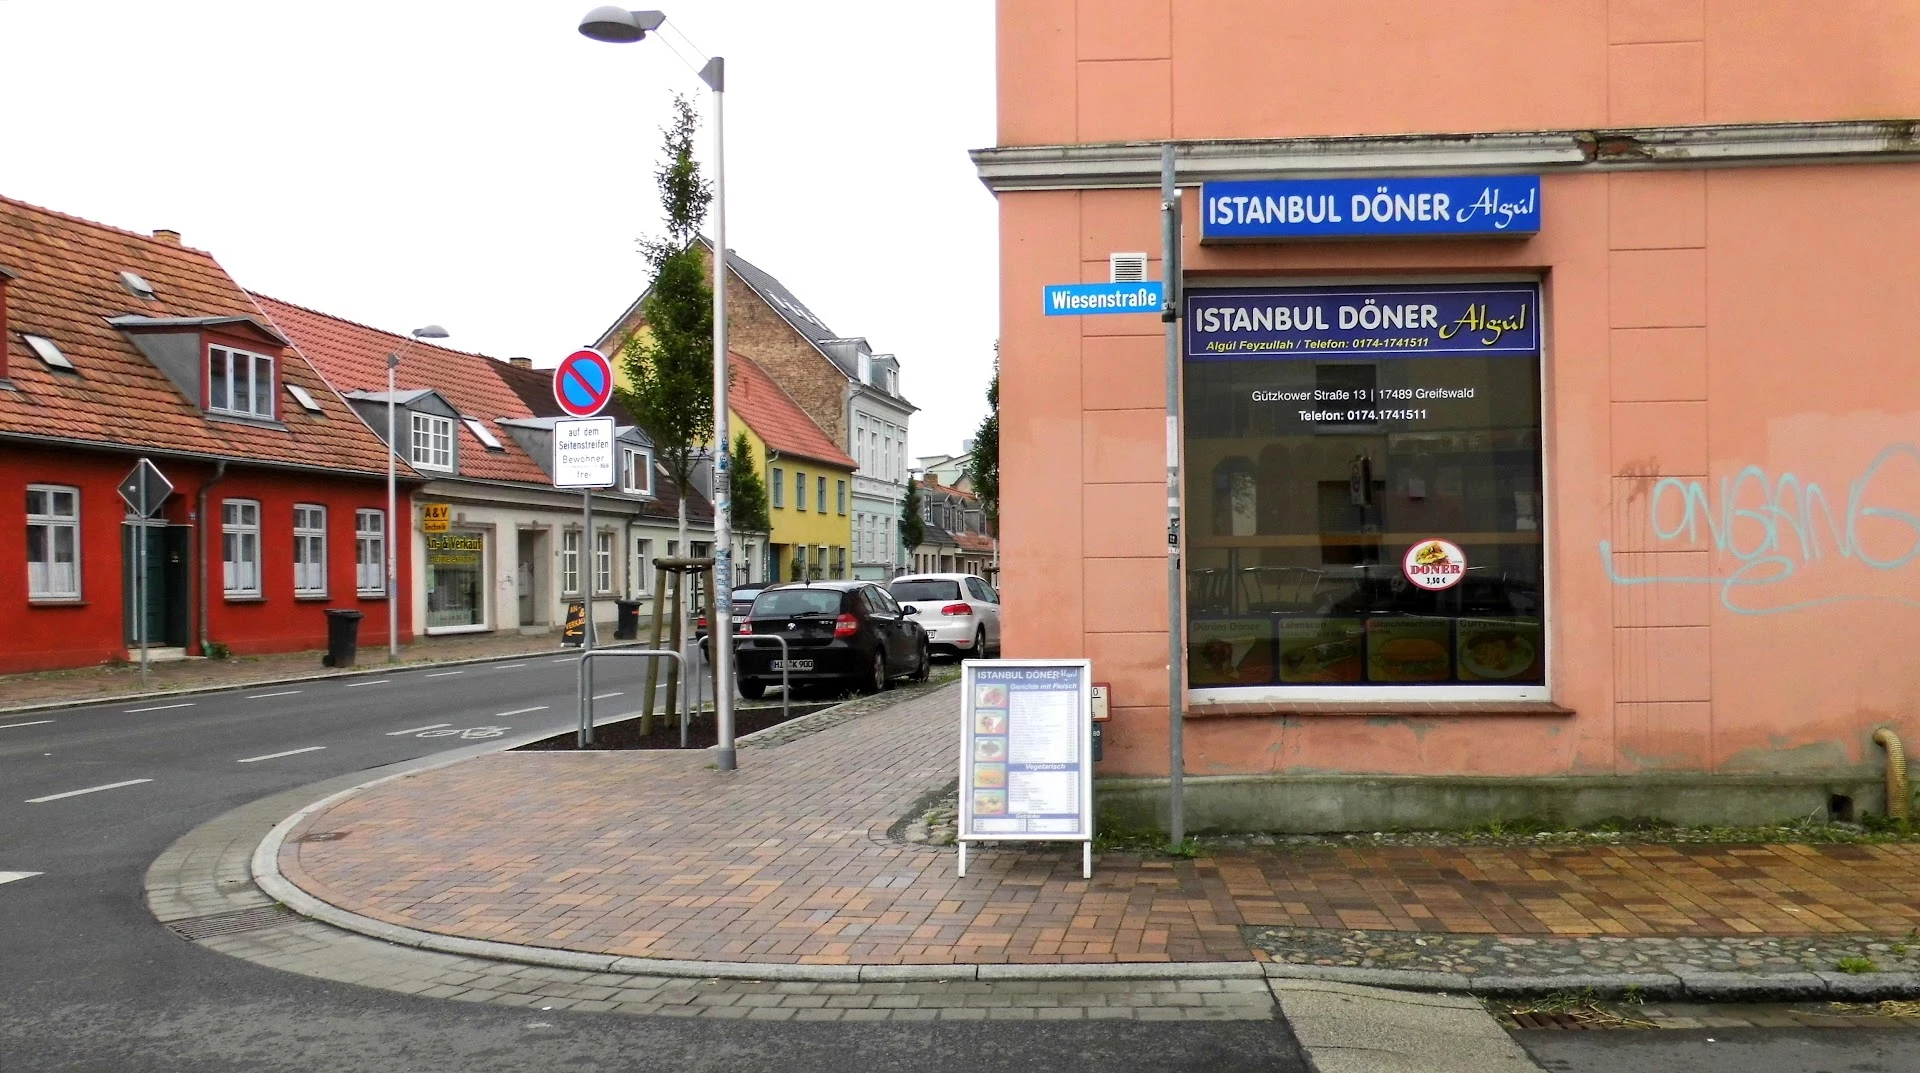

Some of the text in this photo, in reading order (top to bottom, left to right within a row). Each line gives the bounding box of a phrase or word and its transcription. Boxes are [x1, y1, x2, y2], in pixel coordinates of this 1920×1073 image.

[1209, 194, 1342, 225] ISTANBUL
[1351, 186, 1450, 223] DÖNER
[1052, 288, 1157, 310] Wiesenstraße
[1196, 305, 1330, 333] ISTANBUL
[1338, 298, 1438, 330] DÖNER
[1206, 337, 1429, 353] Algúl Feyzullah / Telefon: 0174-1741511
[1252, 390, 1311, 402] Gützkower
[1314, 389, 1350, 400] Straße
[1353, 390, 1366, 400] 13
[1378, 389, 1413, 400] 17489
[1415, 388, 1474, 399] Greifswald
[1299, 409, 1427, 421] Telefon: 0174.1741511
[568, 427, 599, 437] auf dem
[559, 439, 609, 450] Seitenstreifen
[562, 454, 605, 464] Bewohner
[577, 470, 592, 479] frei
[425, 507, 448, 518] A & V
[424, 523, 447, 531] Technik
[442, 535, 450, 550] &
[450, 535, 482, 550] Verkauf
[1426, 577, 1440, 585] 3,50
[977, 671, 1024, 680] ISTANBUL
[1026, 669, 1060, 679] DÖNER
[1025, 763, 1066, 771] Vegetarisch
